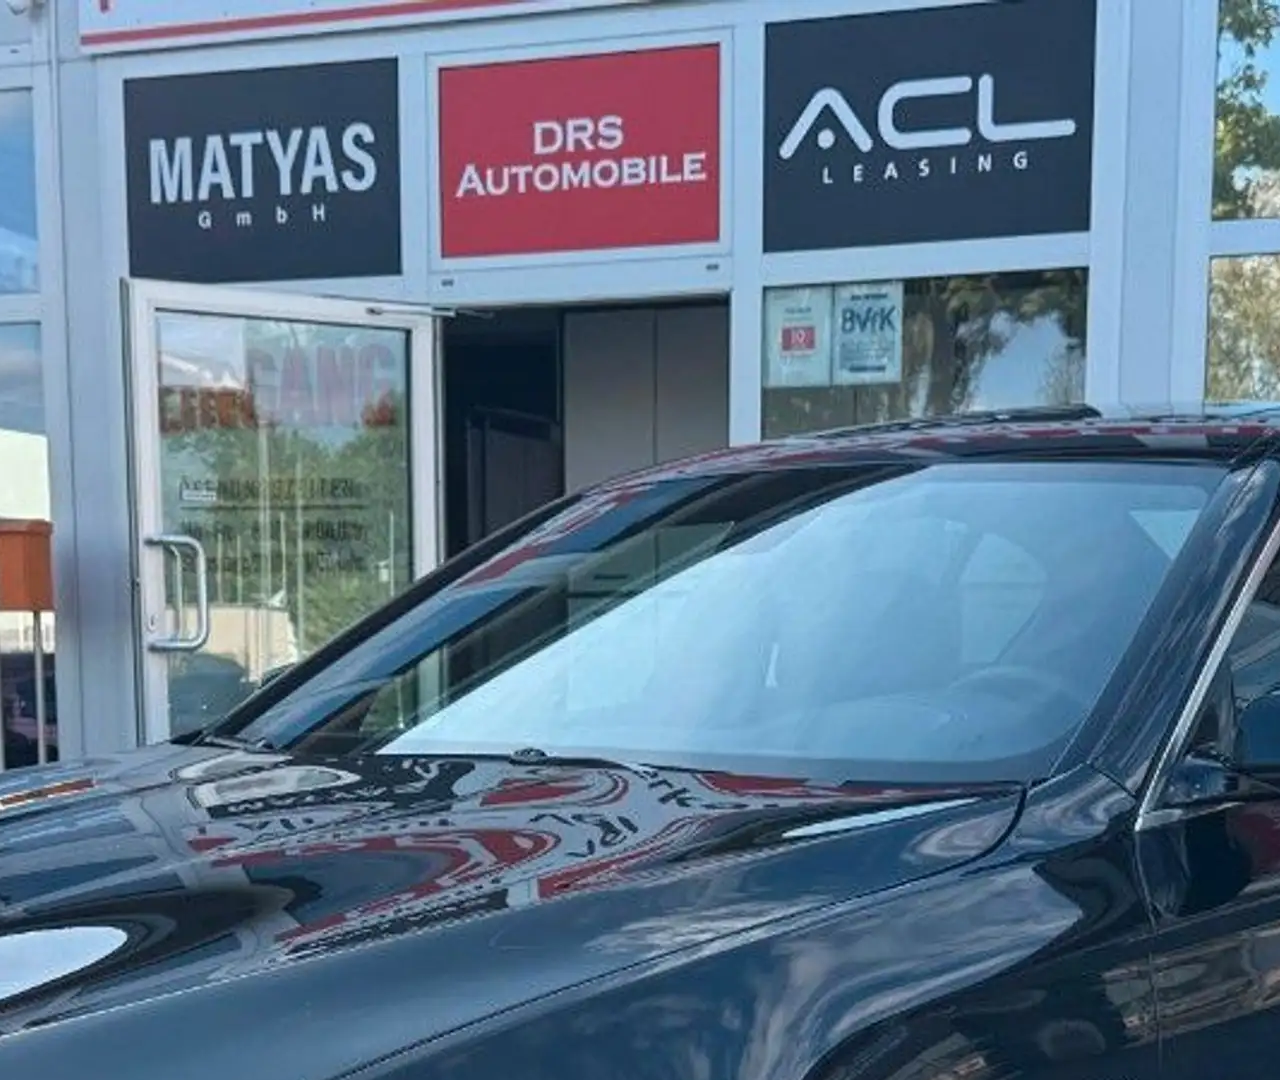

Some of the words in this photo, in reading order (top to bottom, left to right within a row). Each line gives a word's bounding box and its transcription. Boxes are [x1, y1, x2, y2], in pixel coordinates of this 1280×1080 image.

[532, 115, 624, 155] DRS
[778, 73, 1077, 160] ACL
[148, 121, 378, 205] MATYAS
[455, 151, 709, 199] AUTOMOBILE
[821, 150, 1029, 185] LEASING
